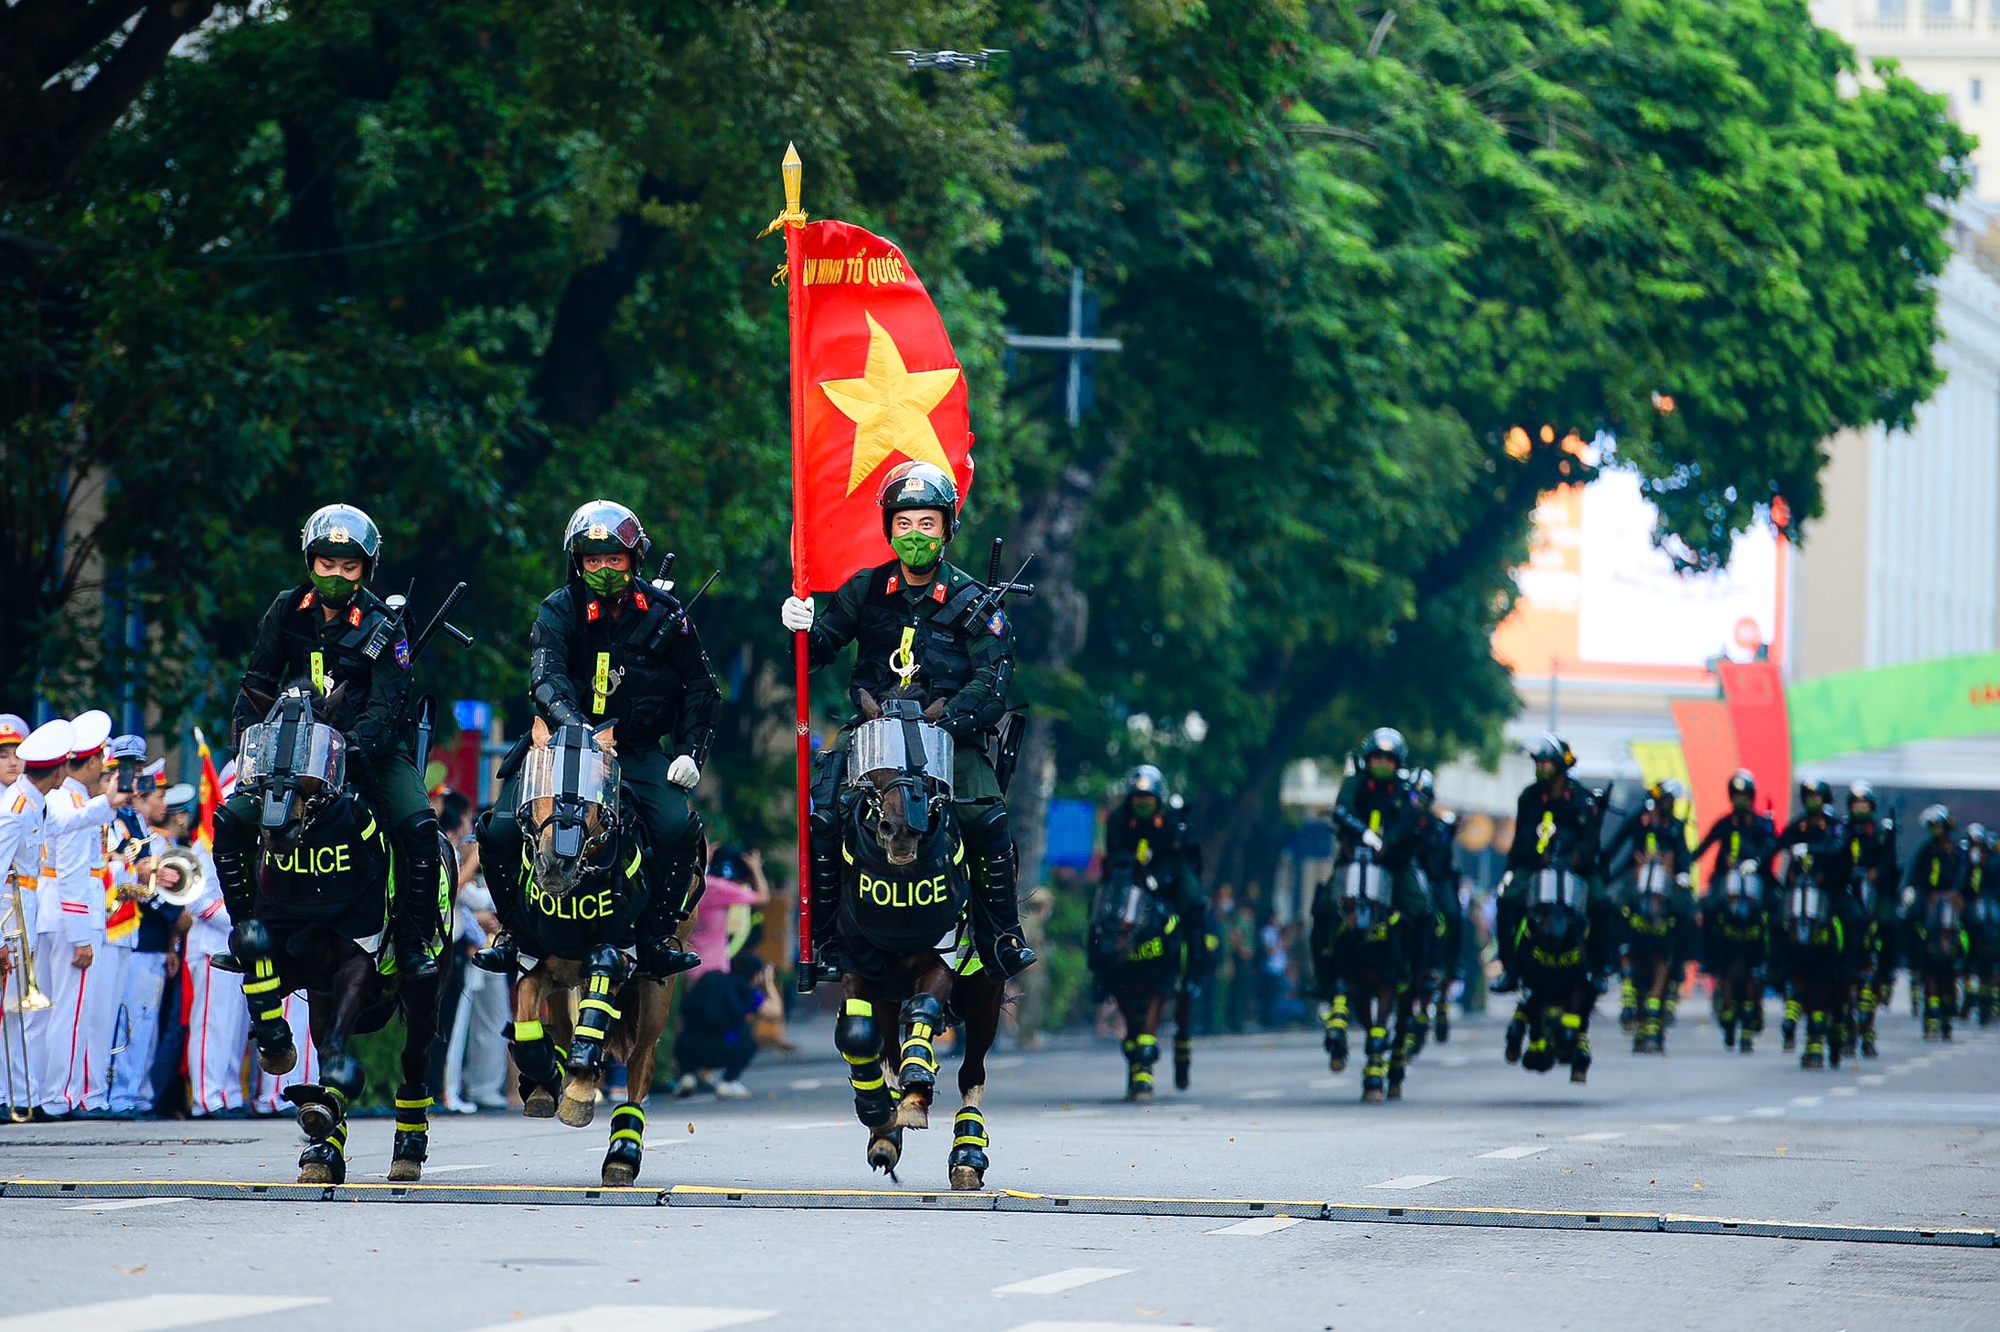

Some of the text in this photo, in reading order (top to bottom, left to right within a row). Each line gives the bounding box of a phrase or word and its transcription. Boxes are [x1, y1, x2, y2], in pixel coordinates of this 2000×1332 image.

[845, 247, 867, 284] TỔ
[867, 248, 906, 287] QUỐC
[530, 881, 614, 919] POLICE
[859, 874, 947, 907] POLICE
